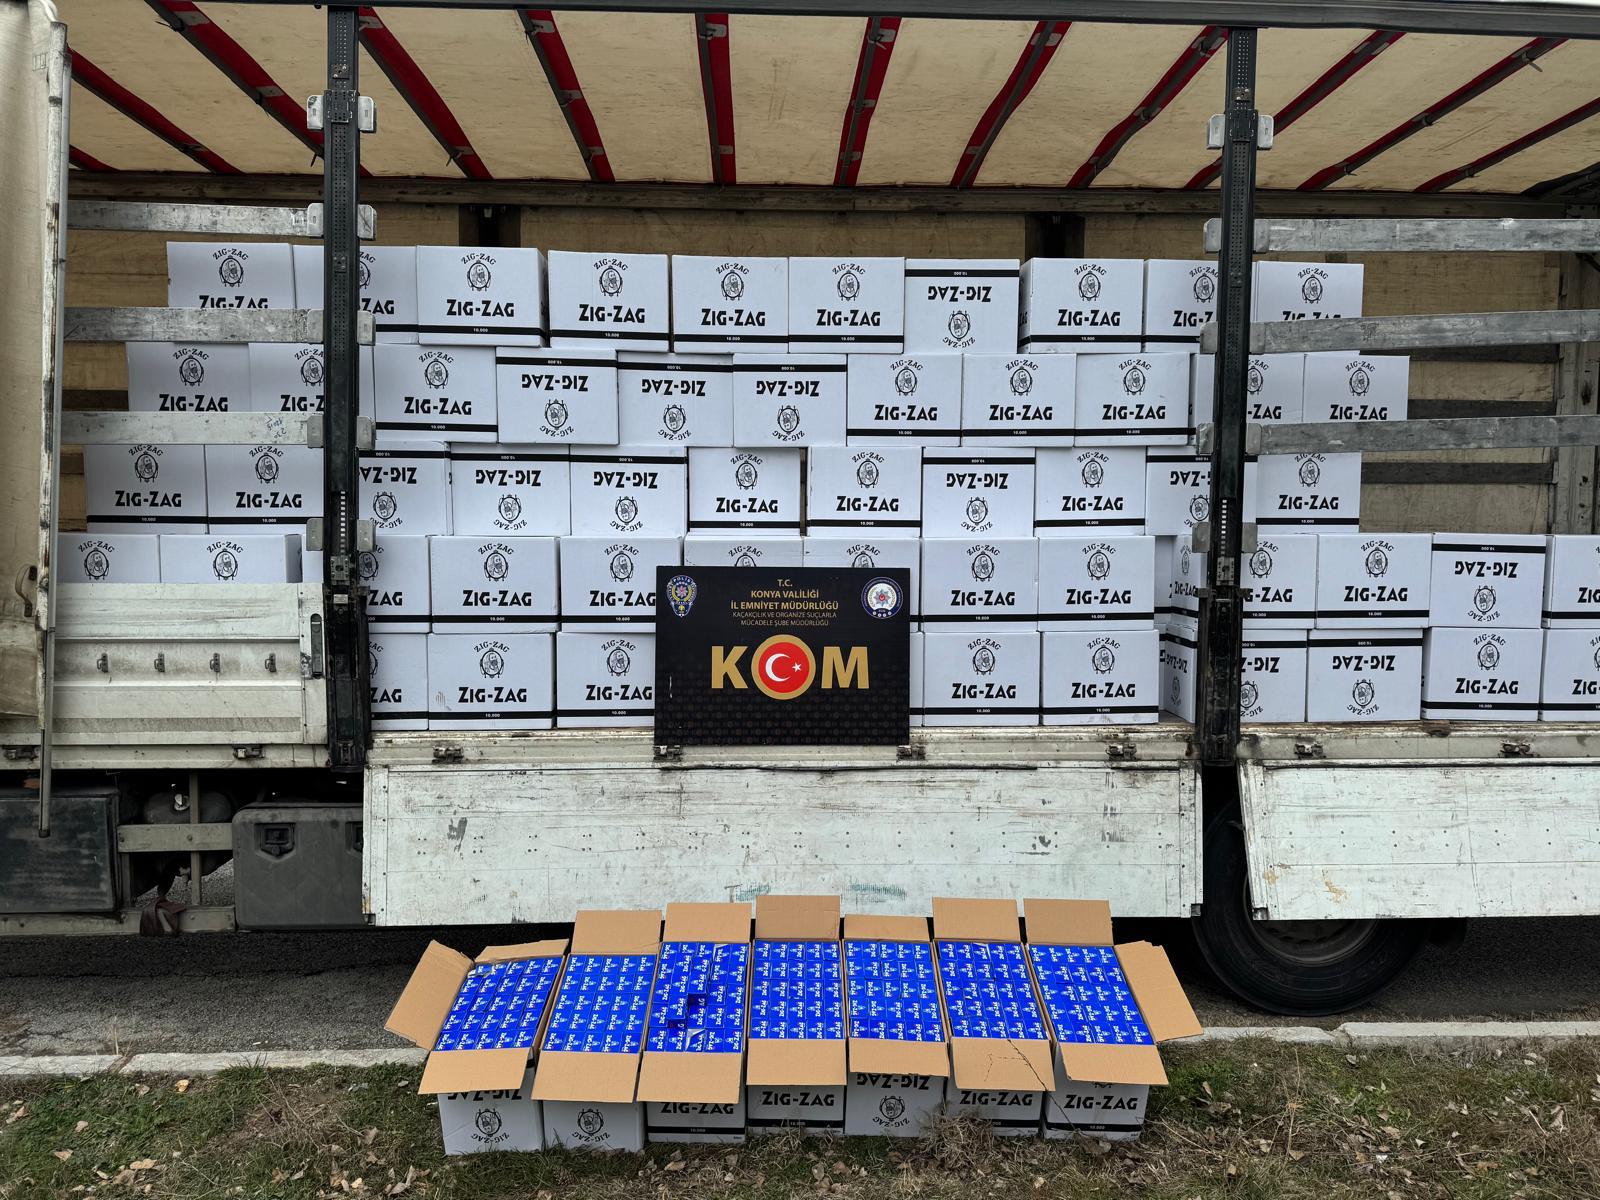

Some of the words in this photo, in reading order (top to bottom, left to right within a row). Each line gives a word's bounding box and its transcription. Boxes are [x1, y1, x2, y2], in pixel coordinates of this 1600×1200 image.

[213, 248, 248, 260] ZIG-ZAG
[461, 252, 496, 265] ZIG-ZAG
[594, 258, 628, 270] ZIG-ZAG
[716, 262, 749, 274] ZIG-ZAG
[832, 264, 865, 274] ZIG-ZAG
[1074, 264, 1106, 275] ZIG-ZAG
[1298, 267, 1329, 278] ZIG-ZAG
[928, 286, 992, 302] ZIG-ZAG
[447, 299, 514, 317] ZIG-ZAG
[579, 304, 645, 323] ZIG-ZAG
[701, 309, 765, 326] ZIG-ZAG
[817, 309, 880, 326] ZIG-ZAG
[1058, 309, 1120, 326] ZIG-ZAG
[1173, 311, 1213, 327] ZIG-Z
[943, 337, 975, 348] ZIG-ZAG
[173, 348, 208, 360] ZIG-ZAG
[295, 349, 324, 360] ZIG-ZA
[419, 351, 454, 363] ZIG-ZAG
[891, 359, 923, 370] ZIG-ZAG
[1006, 359, 1038, 370] ZIG-ZAG
[1119, 359, 1151, 370] ZIG-ZAG
[1247, 360, 1268, 370] -ZAG
[1345, 360, 1375, 371] ZIG-ZAG
[522, 374, 588, 391] ZIG-ZAG
[642, 379, 706, 396] ZIG-ZAG
[757, 381, 819, 396] ZIG-ZAG
[159, 394, 228, 412] ZIG-ZAG
[280, 395, 324, 411] ZIG-Z
[404, 397, 471, 415] ZIG-ZAG
[875, 405, 937, 420] ZIG-ZAG
[989, 405, 1052, 420] ZIG-ZAG
[1102, 404, 1165, 420] ZIG-ZAG
[1248, 404, 1281, 419] -ZAG
[1330, 405, 1387, 420] ZIG-ZAG
[540, 425, 574, 437] ZIG-ZAG
[658, 430, 691, 441] ZIG-ZAG
[771, 431, 804, 442] ZIG-ZAG
[129, 444, 164, 455] ZIG-ZAG
[249, 444, 283, 457] ZIG-ZAG
[731, 453, 763, 465] ZIG-ZAG
[852, 451, 884, 463] ZIG-ZAG
[1077, 451, 1109, 463] ZIG-ZAG
[360, 467, 417, 484] ZIG-ZA
[476, 470, 541, 486] ZIG-ZAG
[594, 472, 658, 489] ZIG-ZAG
[947, 473, 1008, 489] ZIG-ZAG
[1171, 471, 1211, 487] -ZAG
[115, 490, 181, 507] ZIG-ZAG
[236, 492, 301, 508] ZIG-ZAG
[837, 496, 898, 511] ZIG-ZAG
[1062, 496, 1123, 511] ZIG-ZAG
[1278, 495, 1338, 509] ZIG-ZAG
[716, 498, 778, 513] ZIG-ZAG
[493, 519, 527, 531] ZIG-ZAG
[610, 520, 643, 532] ZIG-ZAG
[961, 521, 993, 532] ZIG-ZAG
[79, 540, 115, 552] ZIG-ZAG
[207, 541, 243, 553] ZIG-ZAG
[478, 543, 514, 555] ZIG-ZAG
[605, 544, 638, 555] ZIG-ZAG
[728, 546, 762, 556] ZIG-ZAG
[847, 544, 879, 555] ZIG-ZAG
[966, 544, 1000, 556] ZIG-ZAG
[1082, 543, 1116, 555] ZIG-ZAG
[1257, 540, 1278, 552] -ZAG
[1361, 540, 1393, 552] ZIG-ZAG
[1455, 561, 1518, 578] ZIG-ZAG
[777, 579, 793, 587] T.C.
[463, 590, 531, 606] ZIG-ZAG
[589, 591, 656, 606] ZIG-ZAG
[751, 590, 781, 598] KONYA
[783, 588, 819, 598] VALİLİĞİ
[951, 590, 1015, 606] ZIG-ZAG
[1066, 589, 1131, 604] ZIG-ZAG
[1245, 588, 1293, 603] G-ZAG
[1344, 586, 1407, 601] ZIG-ZAG
[730, 600, 738, 610] İL
[740, 600, 779, 610] EMNİYET
[781, 600, 839, 610] MÜDÜRLÜĞÜ
[1467, 610, 1500, 622] ZIG-ZAG
[474, 640, 509, 652] ZIG-ZAG
[601, 640, 635, 650] ZIG-ZAG
[967, 639, 1001, 650] ZIG-ZAG
[1087, 638, 1120, 650] ZIG-ZAG
[1473, 634, 1505, 645] ZIG-ZAG
[1241, 657, 1280, 673] ZIG-Z
[1333, 655, 1395, 671] ZIG-ZAG
[586, 685, 652, 700] ZIG-ZAG
[952, 683, 1016, 698] ZIG-ZAG
[1071, 683, 1135, 698] ZIG-ZAG
[1455, 678, 1518, 694] ZIG-ZAG
[458, 687, 526, 703] ZIG-ZAG
[1241, 705, 1263, 716] ZIG-Z
[1346, 703, 1379, 715] ZIG-ZAG
[857, 1074, 929, 1091] ZIG-ZAG
[762, 1091, 834, 1106] ZIG-ZAG
[960, 1090, 1033, 1106] ZIG-ZAG
[1064, 1094, 1138, 1110] ZIG-ZAG
[660, 1102, 735, 1115] ZIG-ZAG
[873, 1116, 909, 1128] ZIG-ZAG
[472, 1132, 510, 1144] ZIG-ZAG
[572, 1132, 609, 1143] ZIG-ZAG
